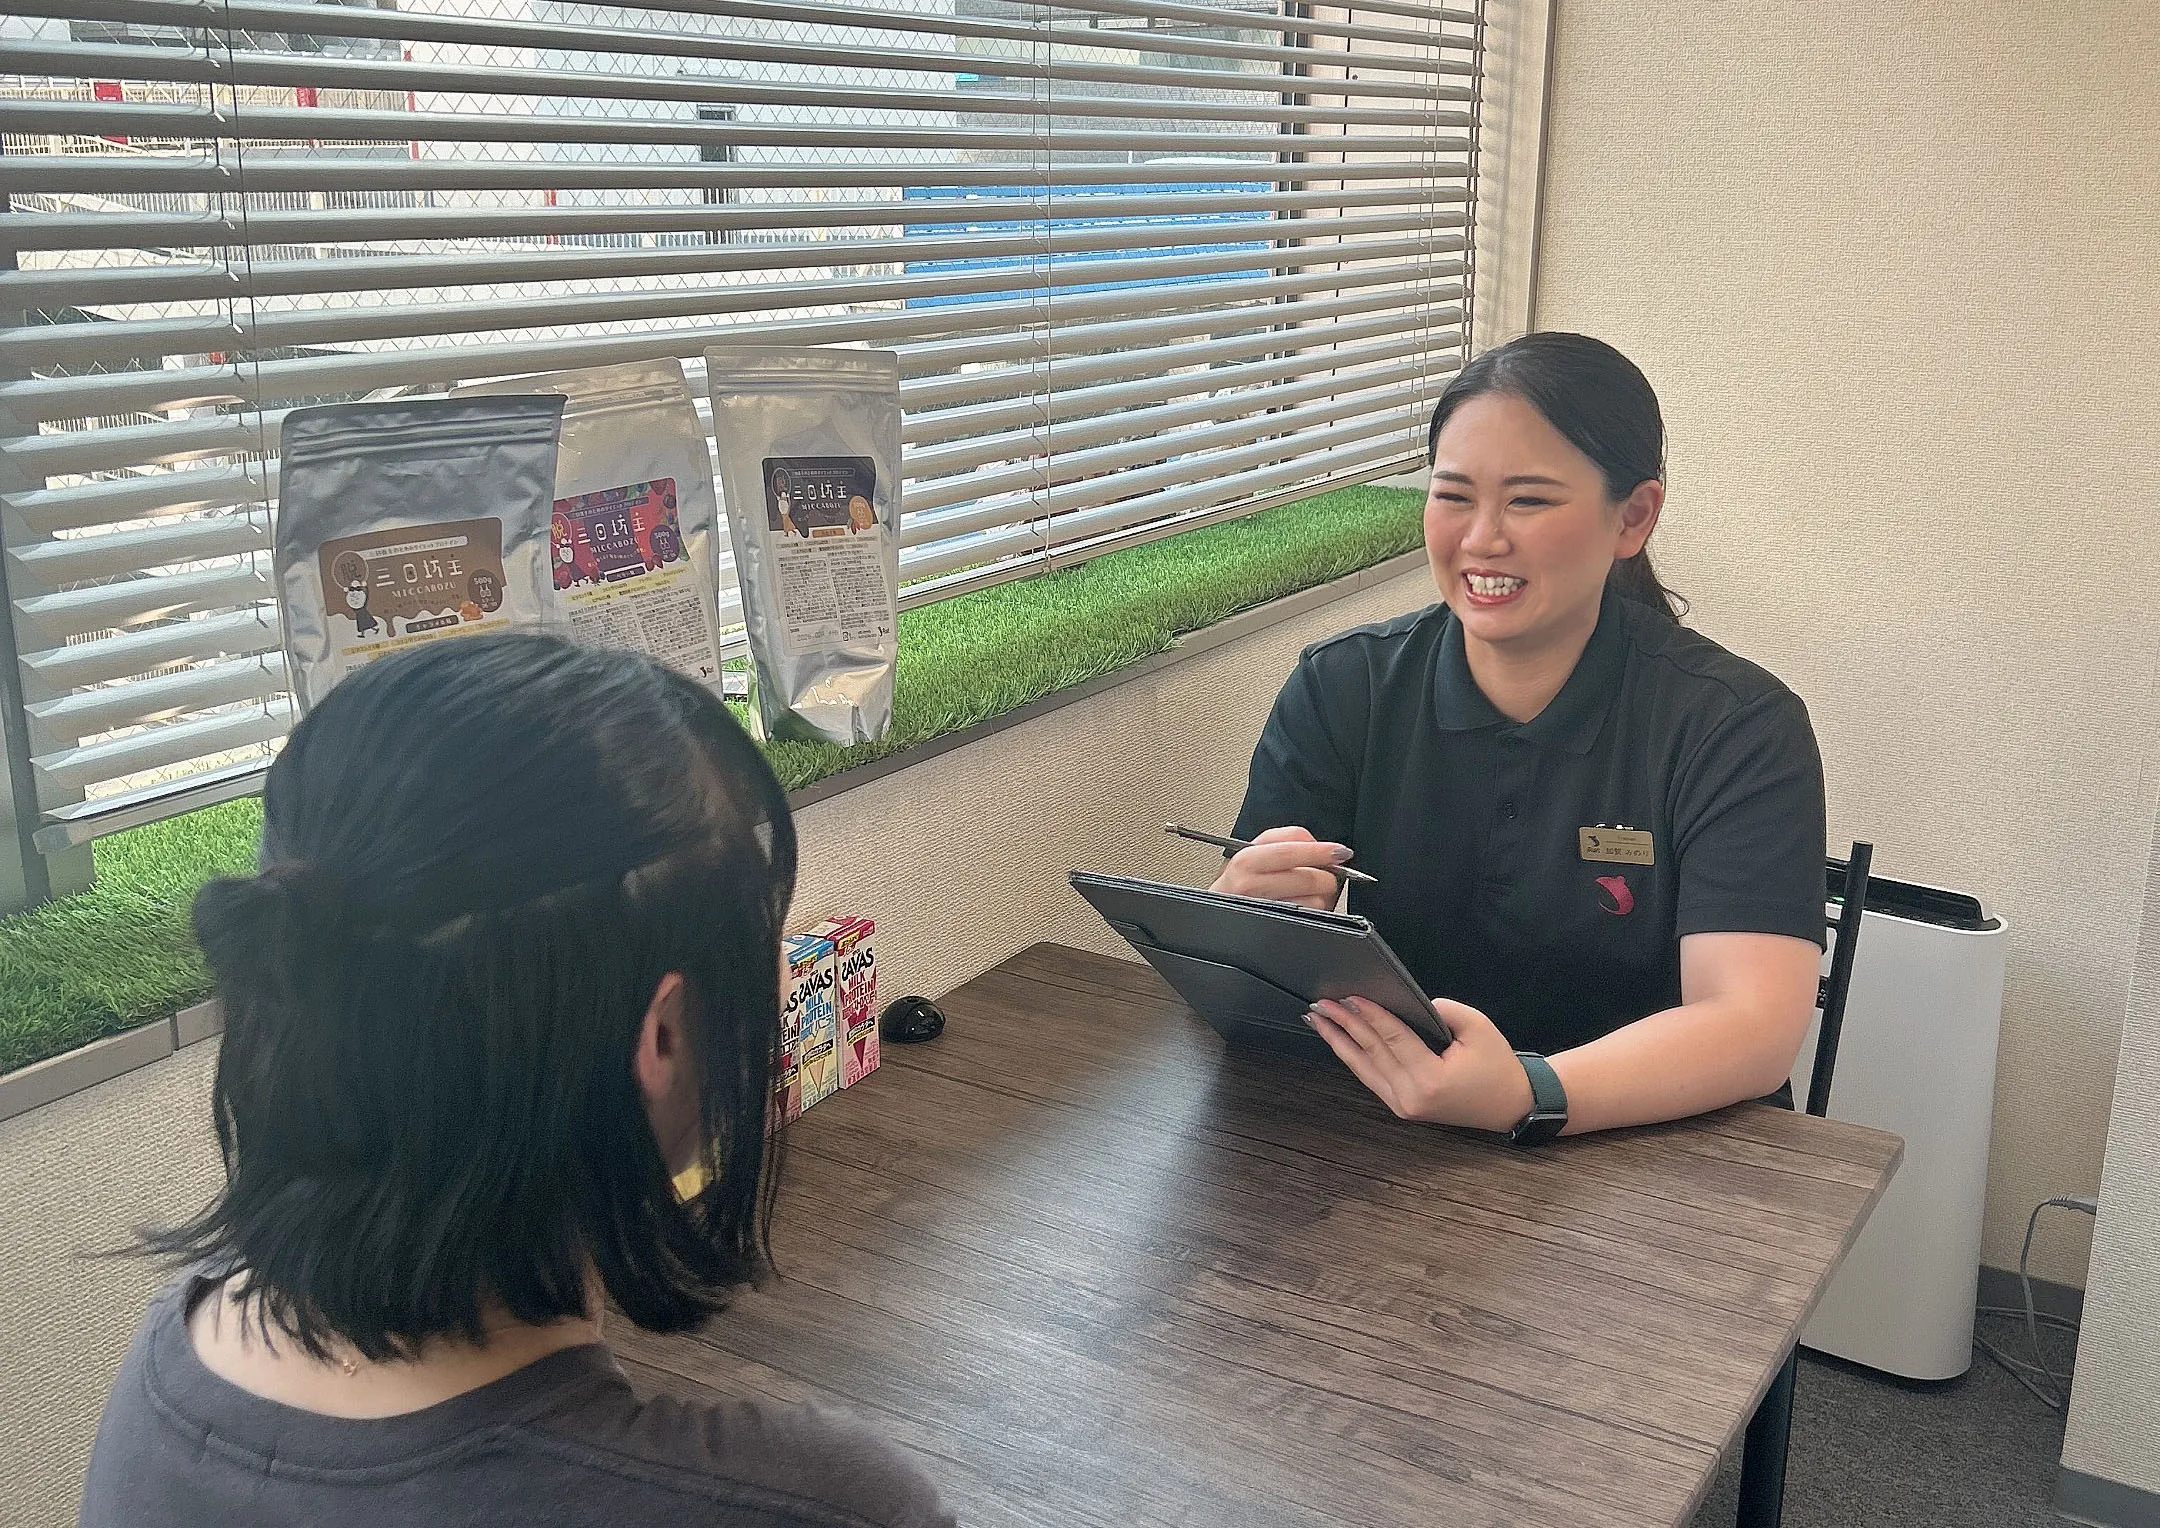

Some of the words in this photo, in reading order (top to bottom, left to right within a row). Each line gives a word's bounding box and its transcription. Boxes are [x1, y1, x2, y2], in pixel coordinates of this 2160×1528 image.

[576, 512, 646, 544] 三日坊主
[376, 554, 463, 587] 三日坊主
[842, 947, 874, 981] SAVAS
[799, 968, 833, 1003] SAVAS
[844, 980, 875, 1006] PROTEIN
[849, 970, 866, 991] MILK
[801, 1001, 832, 1028] PROTEIN
[806, 991, 824, 1012] MILK
